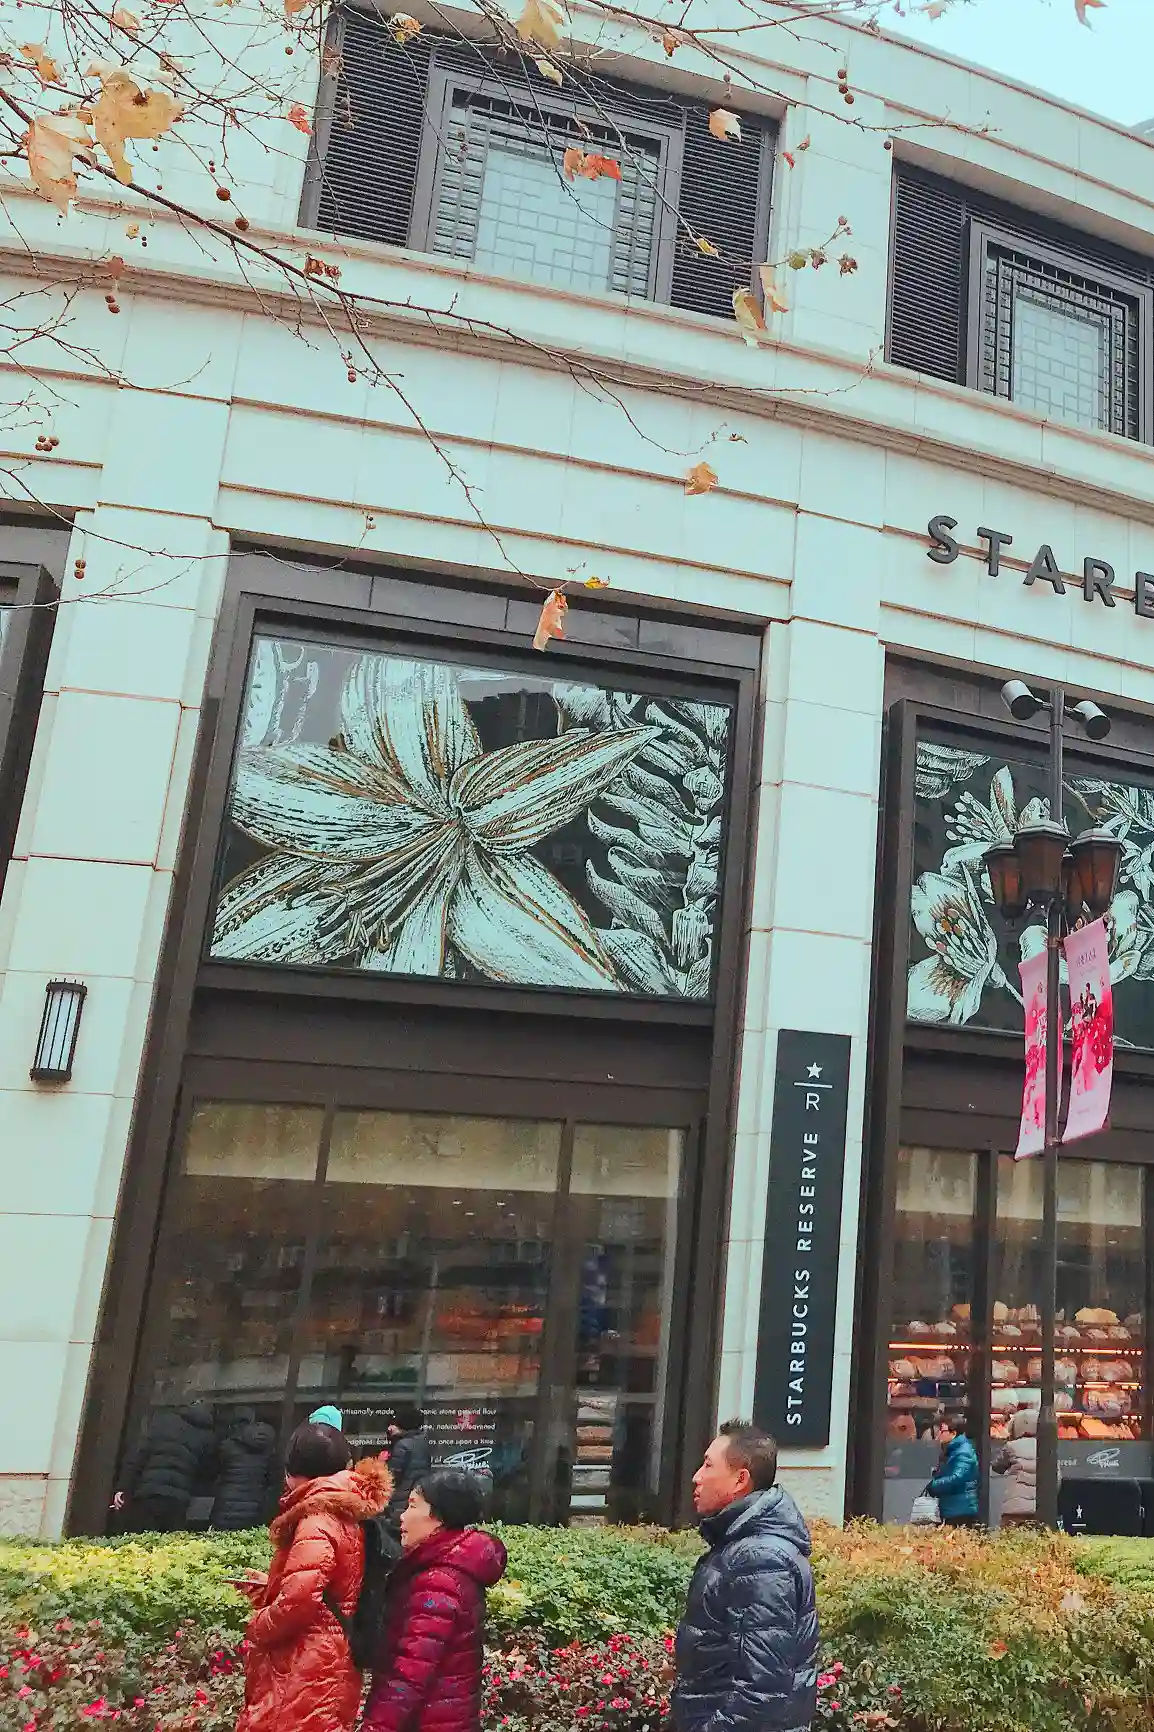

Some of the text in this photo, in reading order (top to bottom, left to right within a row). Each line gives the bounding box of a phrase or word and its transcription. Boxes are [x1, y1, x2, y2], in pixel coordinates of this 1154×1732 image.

[805, 1092, 821, 1111] R
[786, 1132, 818, 1426] STARBUCKS RESERVE
[375, 1407, 395, 1415] made
